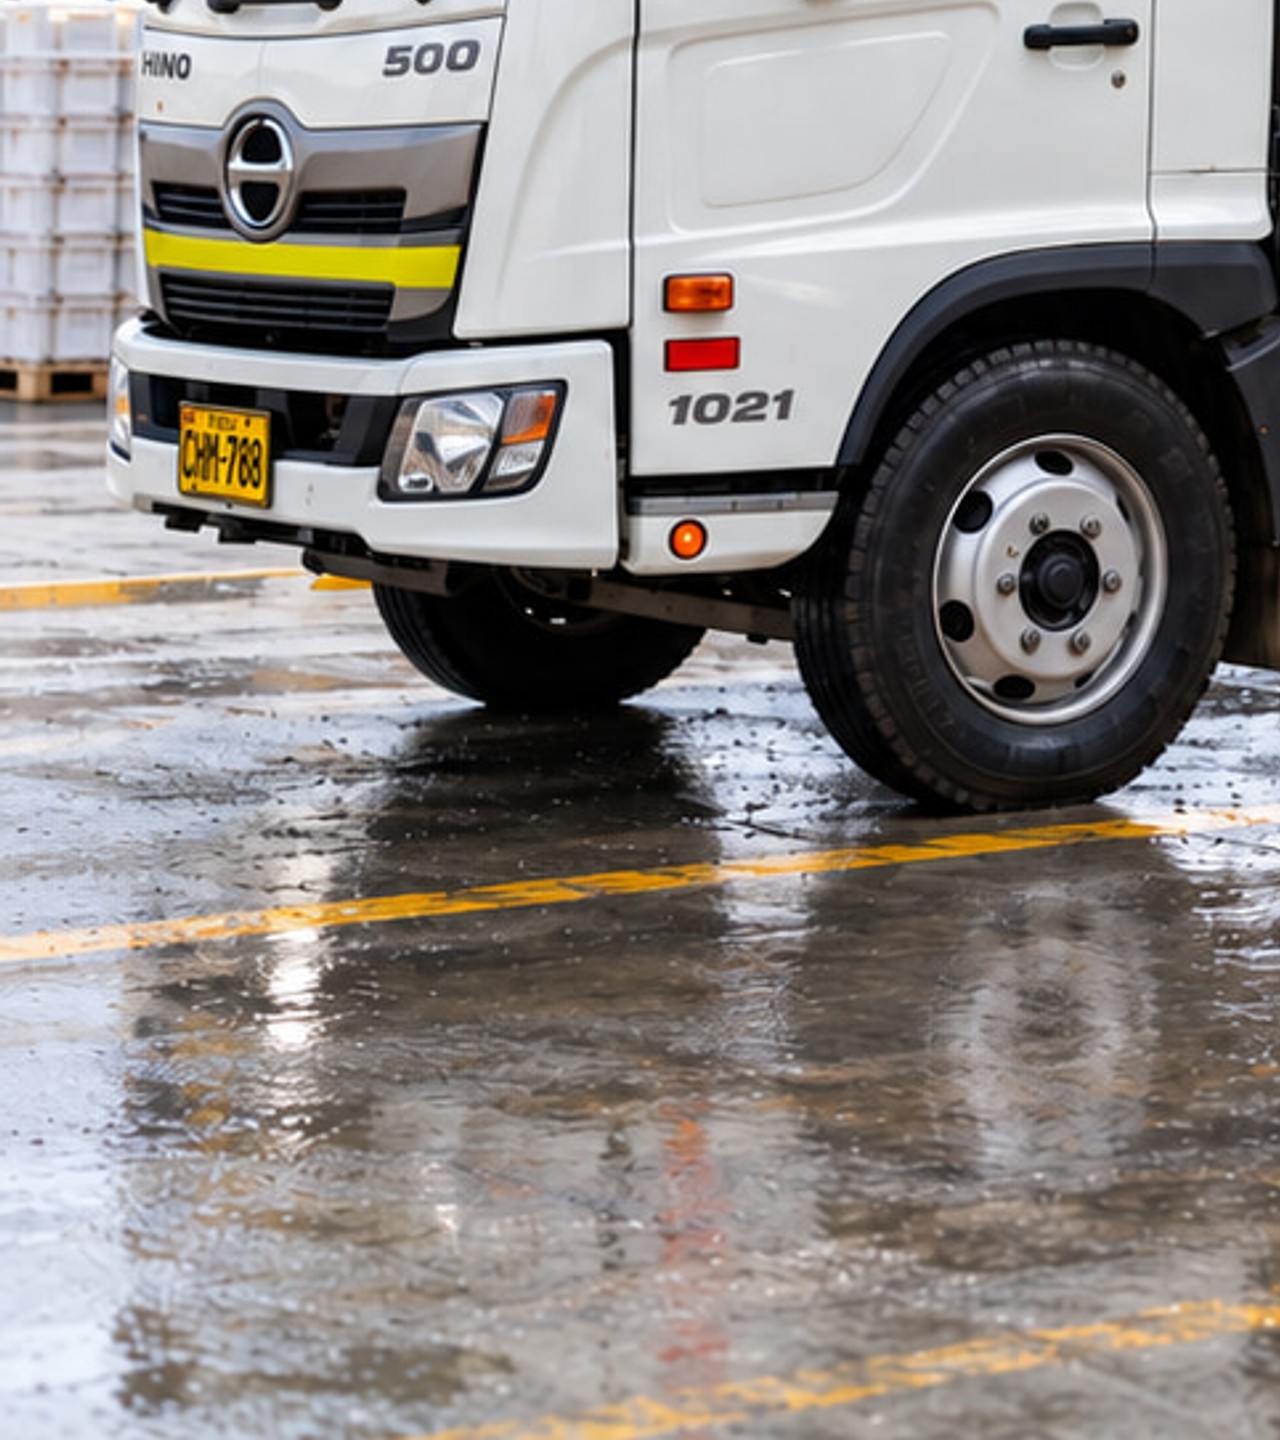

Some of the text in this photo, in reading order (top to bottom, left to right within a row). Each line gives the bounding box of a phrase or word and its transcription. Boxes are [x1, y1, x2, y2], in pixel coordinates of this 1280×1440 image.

[140, 50, 192, 80] HINO
[382, 39, 481, 77] 500
[669, 389, 795, 426] 1021
